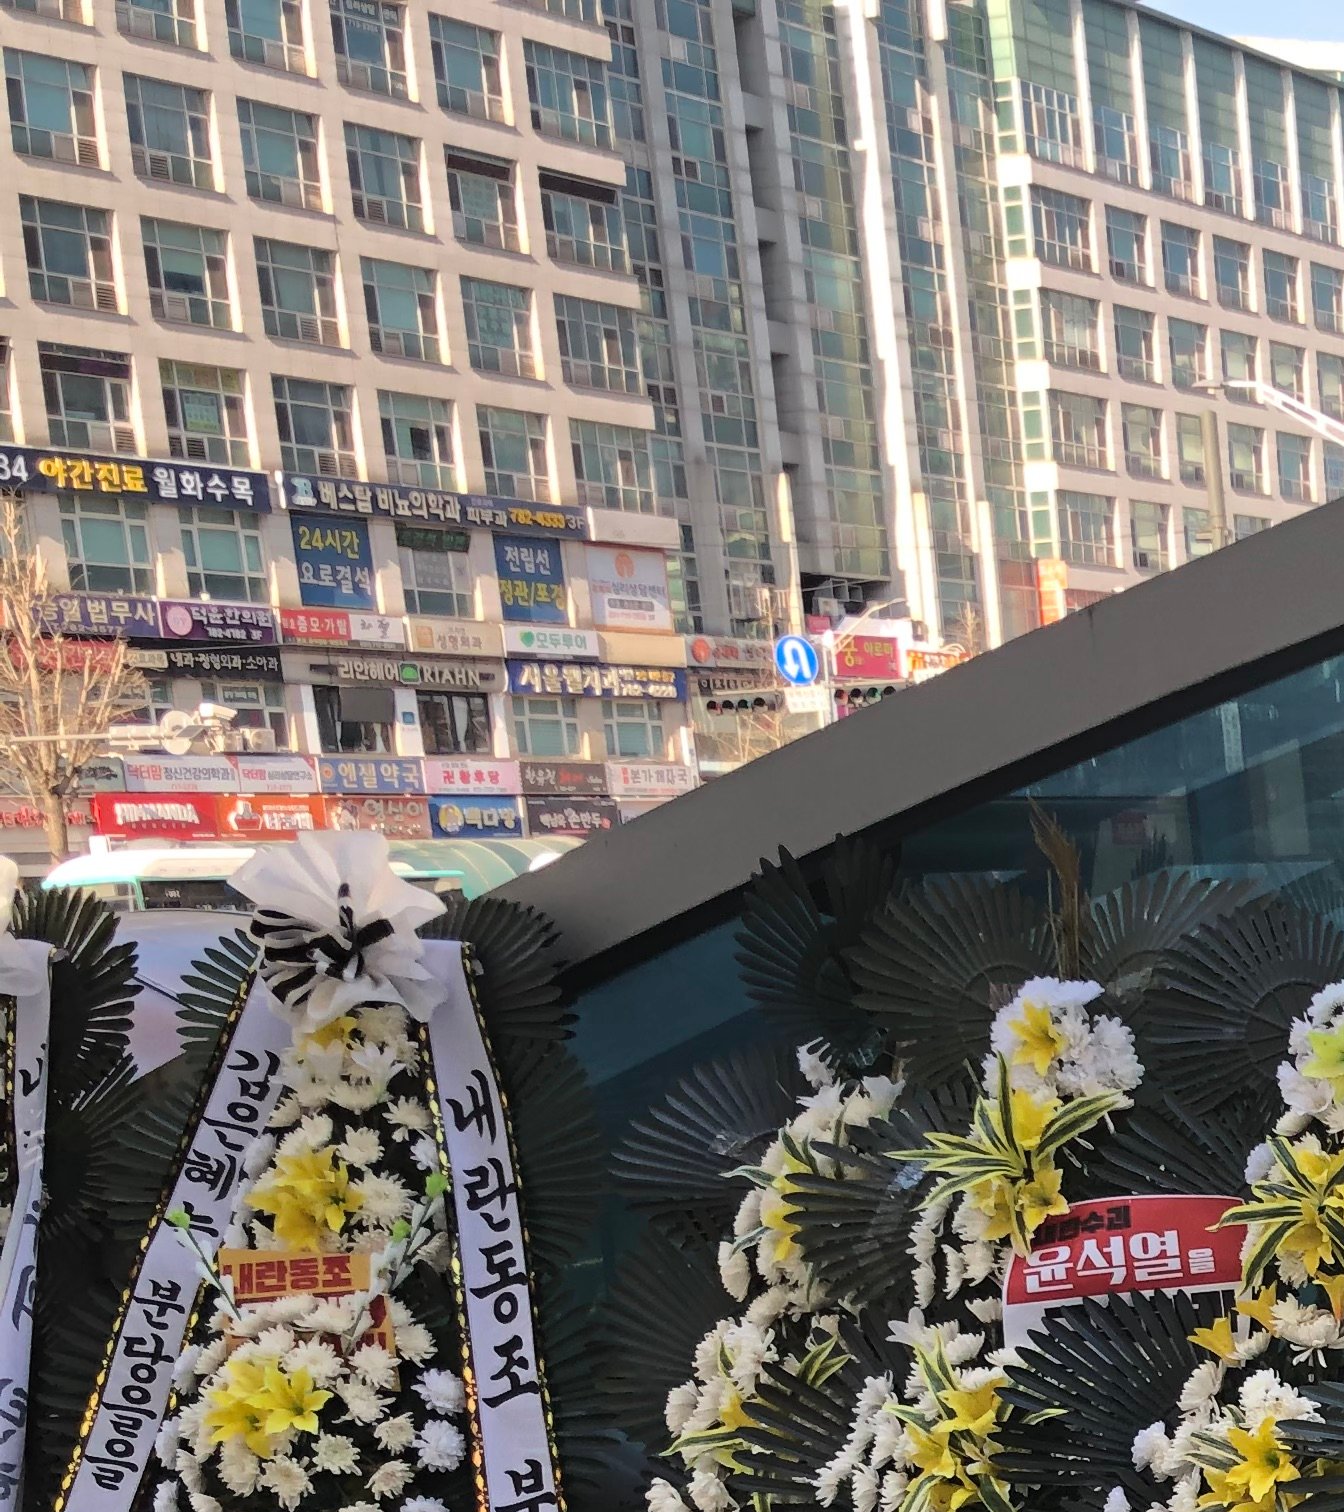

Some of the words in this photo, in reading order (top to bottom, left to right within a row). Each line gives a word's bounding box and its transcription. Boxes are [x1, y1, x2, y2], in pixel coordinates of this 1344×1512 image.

[38, 456, 148, 493] 야간진료
[152, 466, 255, 507] 월화수목
[374, 486, 461, 524] 비뇨의학과
[466, 507, 508, 528] 피부과
[299, 525, 360, 560] 24시간
[503, 545, 551, 576] 전립선
[299, 561, 371, 596] 요로결석
[87, 599, 155, 626] 법무사
[536, 631, 587, 650] 모두투어
[339, 660, 400, 682] 리안헤어
[423, 664, 481, 687] RIAHN
[338, 762, 420, 789] 엔젤약국
